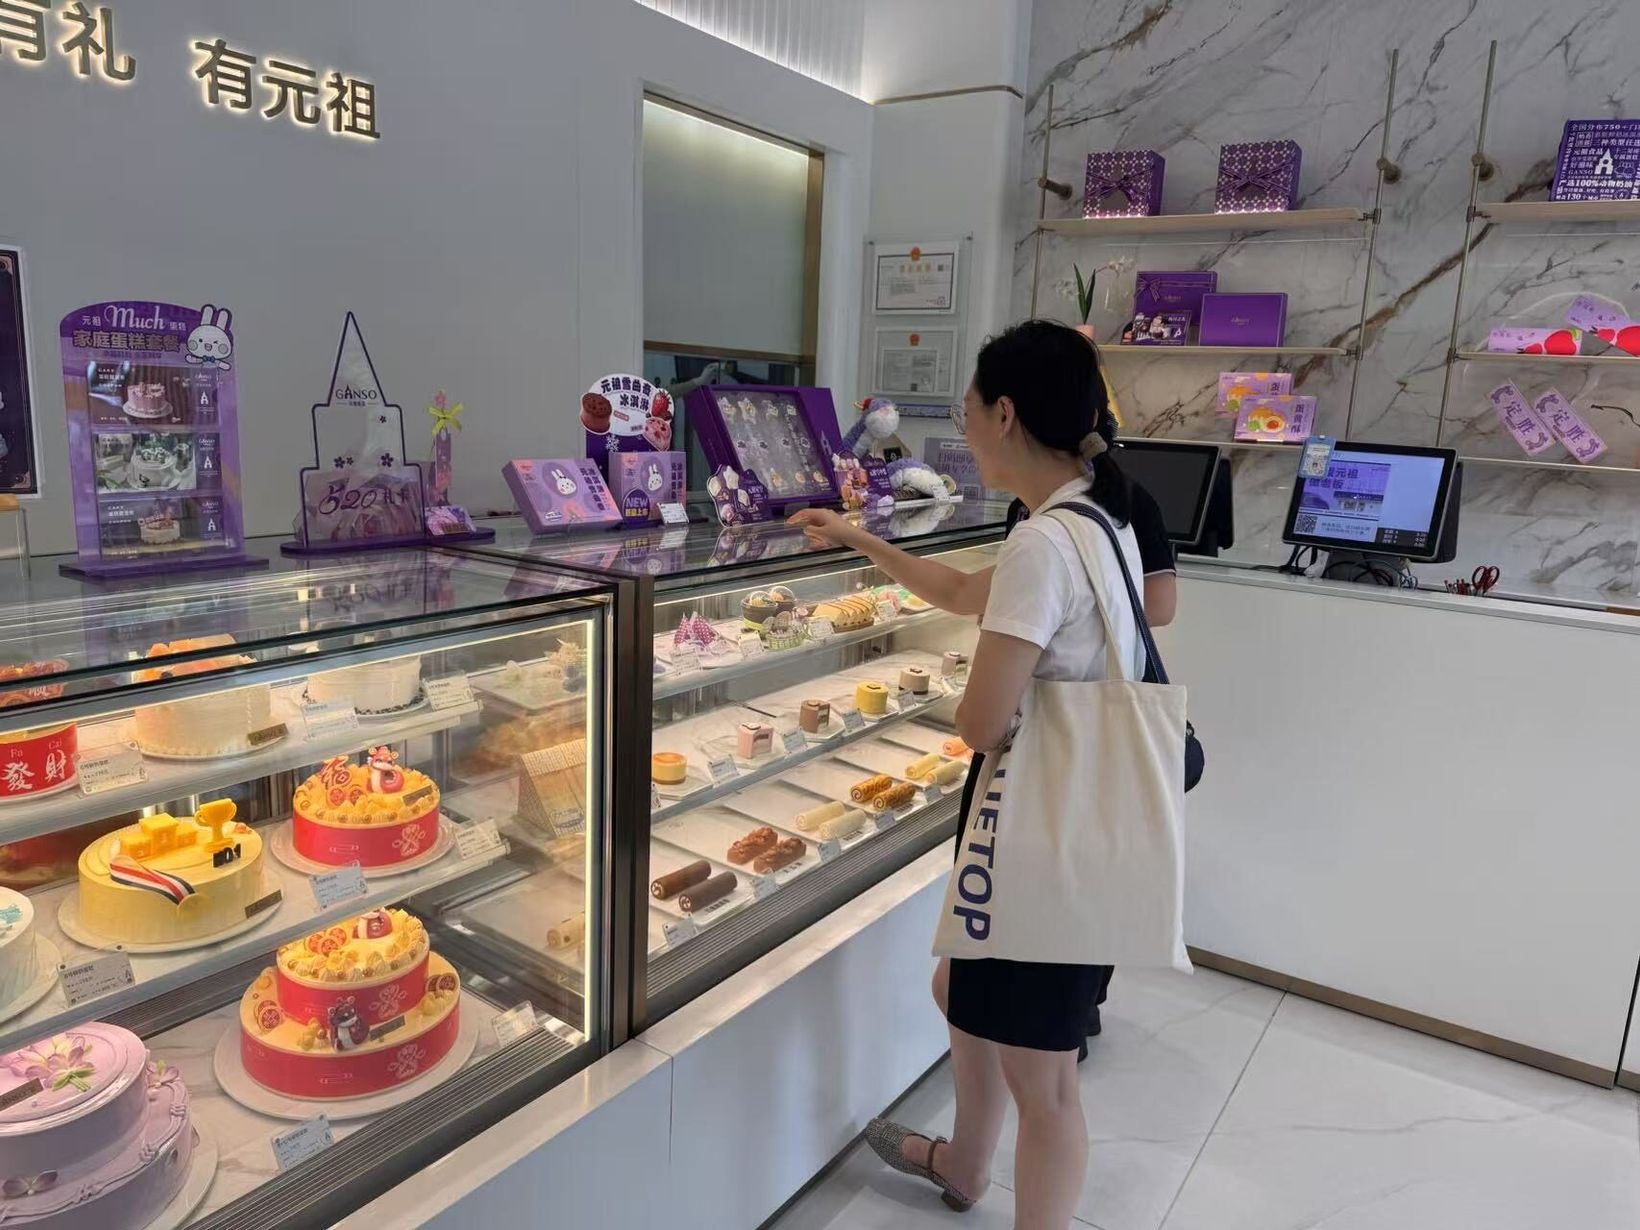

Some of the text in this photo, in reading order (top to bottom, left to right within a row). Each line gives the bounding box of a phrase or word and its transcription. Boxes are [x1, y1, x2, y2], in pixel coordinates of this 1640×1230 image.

[195, 39, 380, 138] 有元祖
[82, 316, 101, 326] 元祖
[104, 305, 165, 330] Much
[336, 384, 377, 399] GANSO
[620, 394, 649, 411] 冰淇淋
[1503, 401, 1536, 437] 定胜
[1549, 409, 1585, 445] 定胜
[626, 497, 648, 508] NEW
